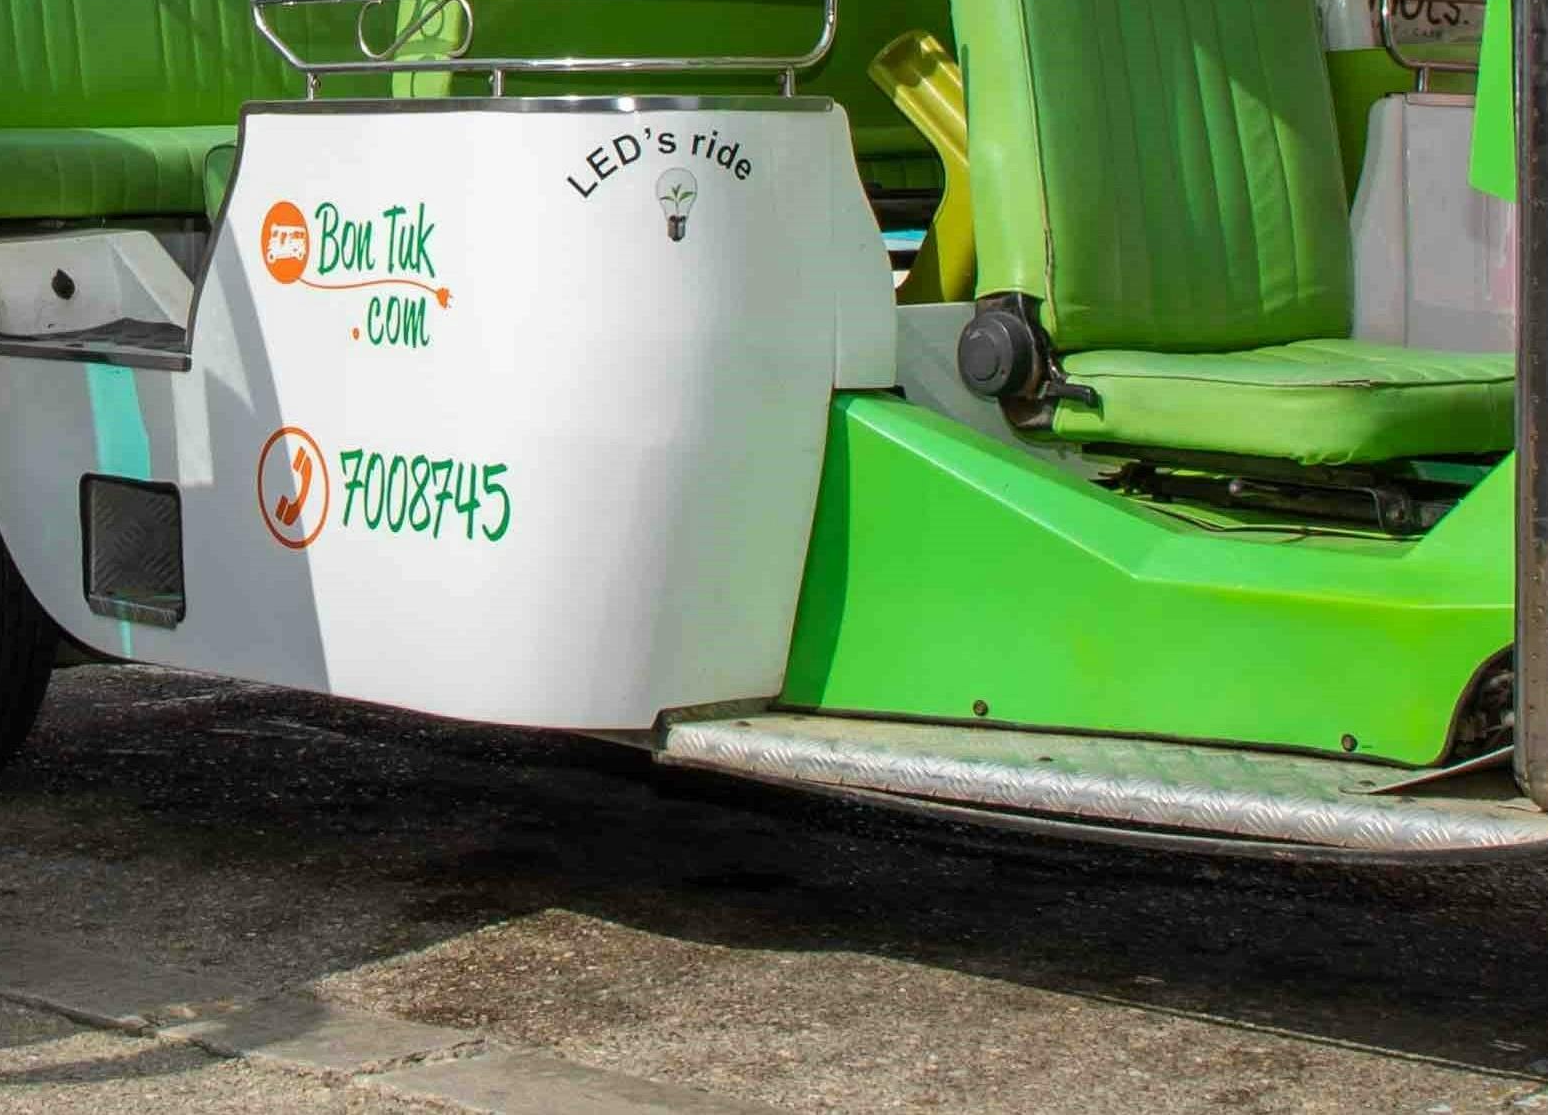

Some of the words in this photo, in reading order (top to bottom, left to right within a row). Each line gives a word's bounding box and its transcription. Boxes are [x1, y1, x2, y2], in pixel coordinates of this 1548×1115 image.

[567, 128, 677, 198] LED's
[691, 130, 752, 181] ride
[314, 202, 375, 276] Bon
[383, 202, 436, 278] Tuk
[340, 449, 511, 542] 7008745
